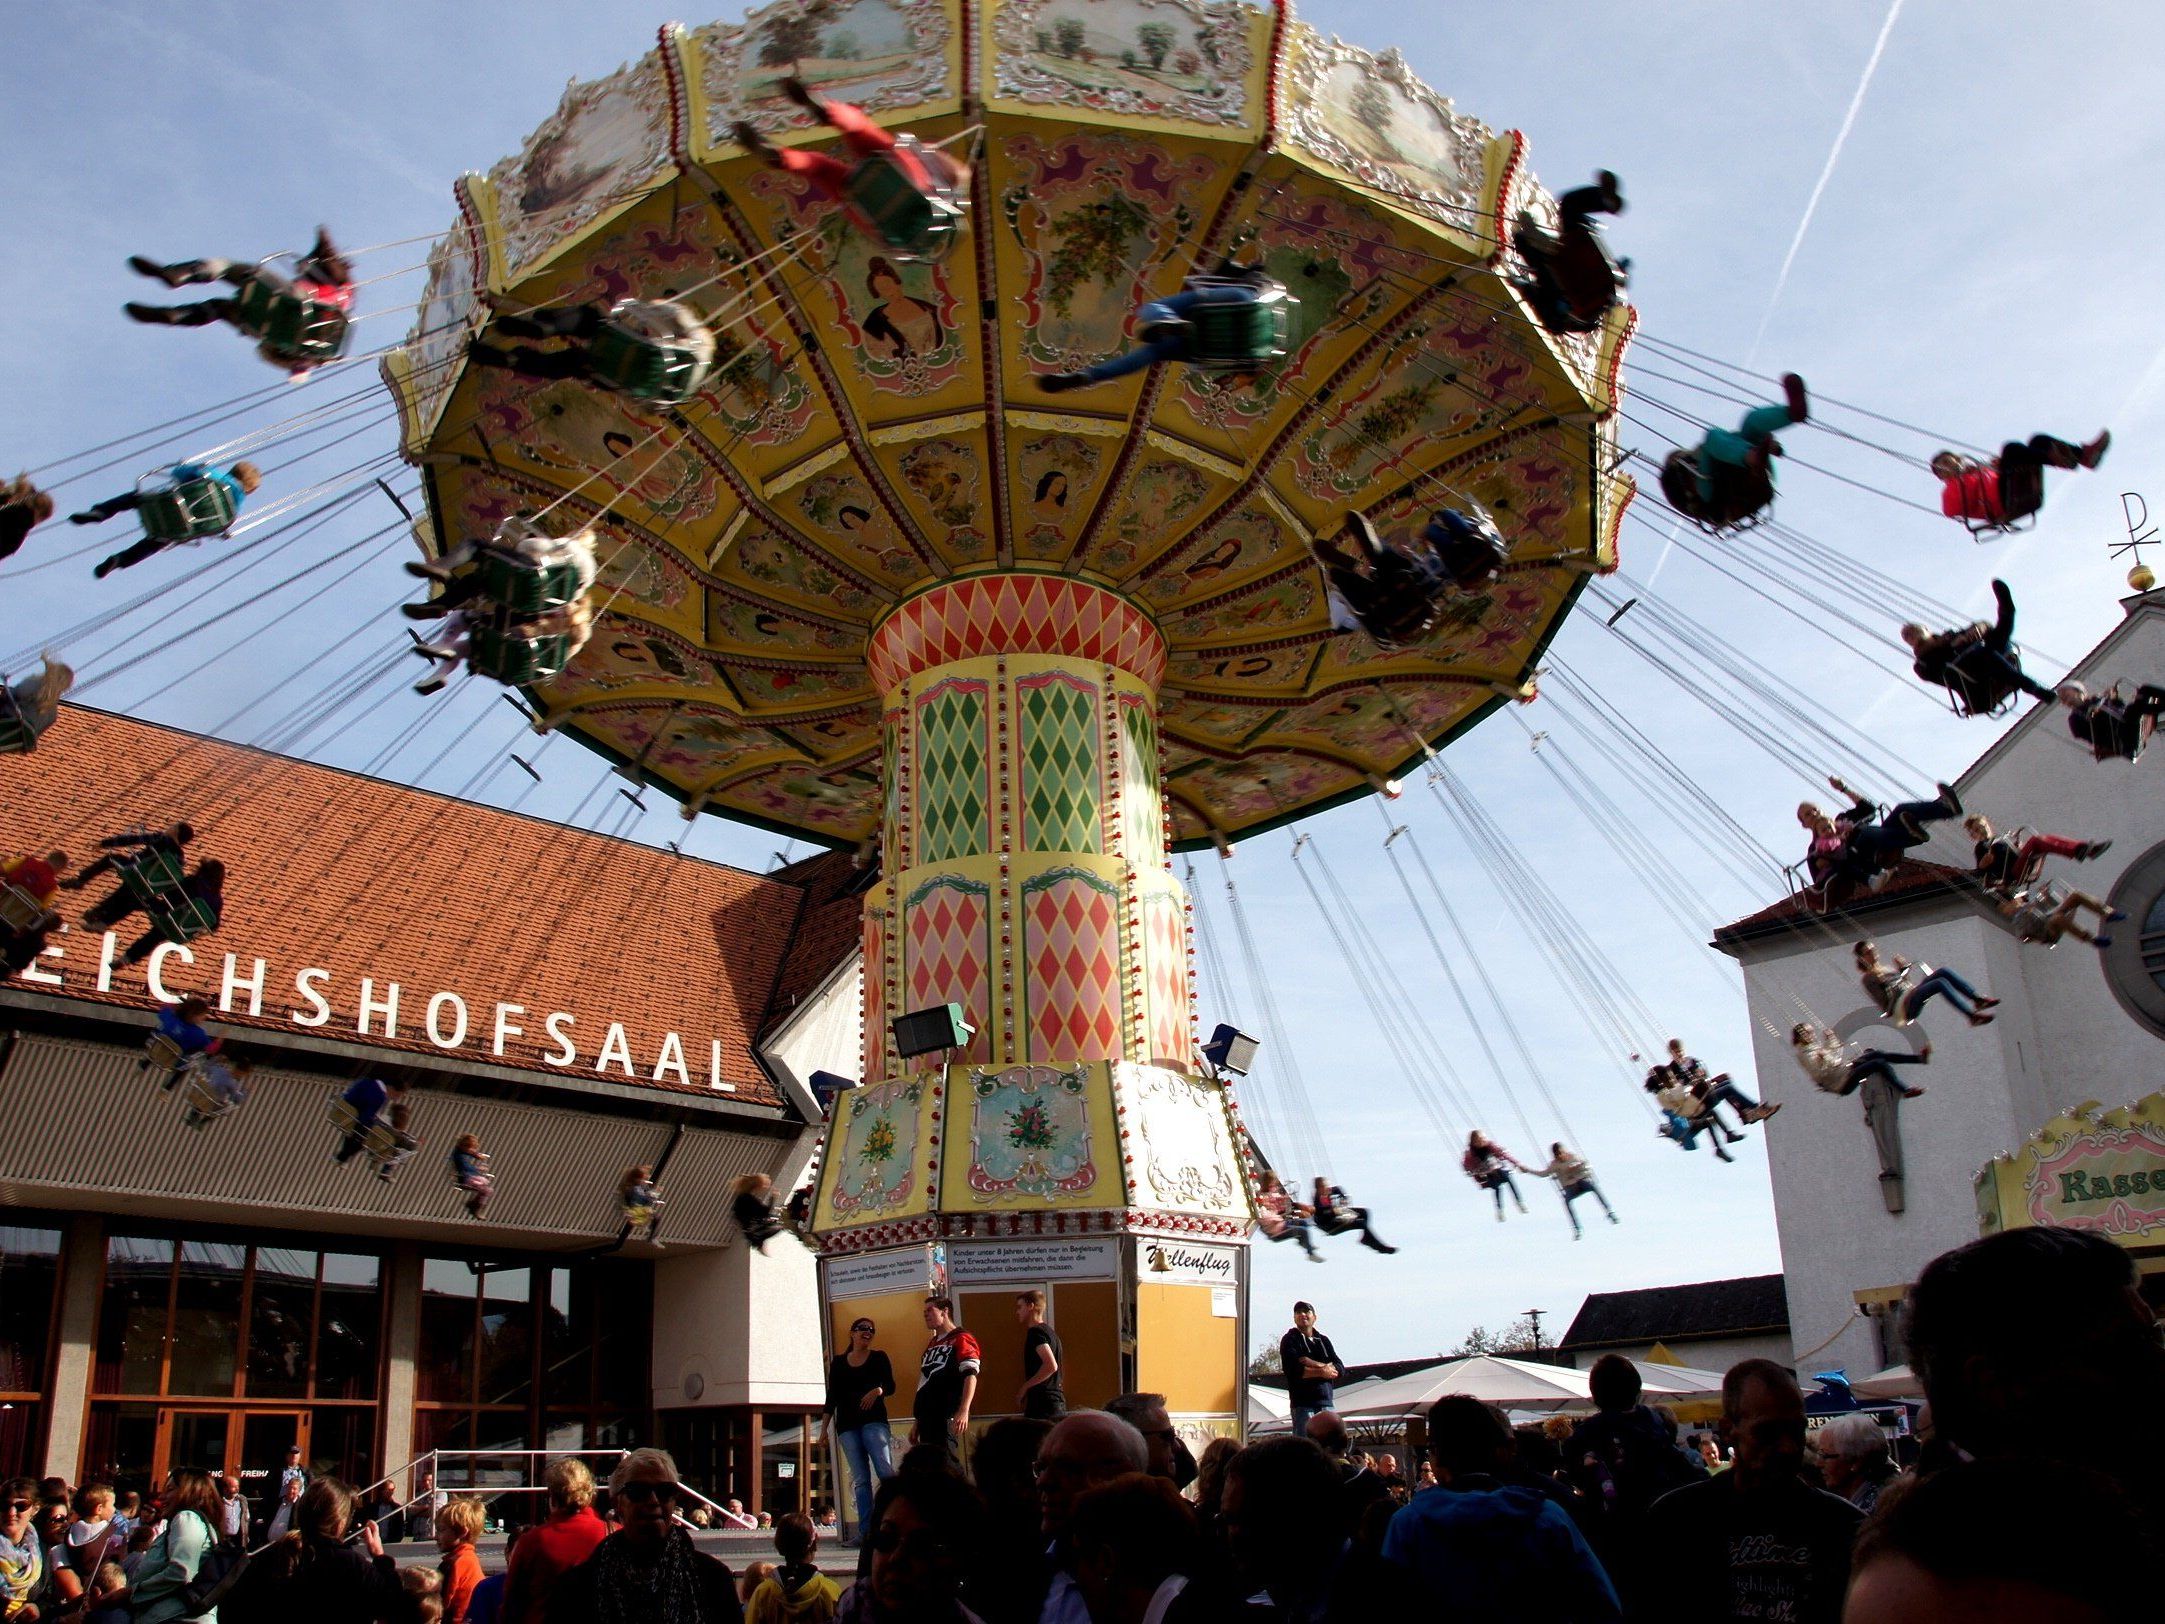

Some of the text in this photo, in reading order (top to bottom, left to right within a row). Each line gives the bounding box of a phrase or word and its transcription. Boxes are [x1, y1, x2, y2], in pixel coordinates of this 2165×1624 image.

[2059, 1168, 2165, 1203] Kasse
[953, 1249, 975, 1257] Kinder
[1003, 1248, 1024, 1256] Jahren
[1025, 1246, 1047, 1254] dürfen
[1069, 1245, 1104, 1254] Begleitung
[967, 1257, 1010, 1265] Erwachsenen
[953, 1266, 1003, 1274] Aufsichtspflicht
[1005, 1264, 1046, 1272] übernehmen
